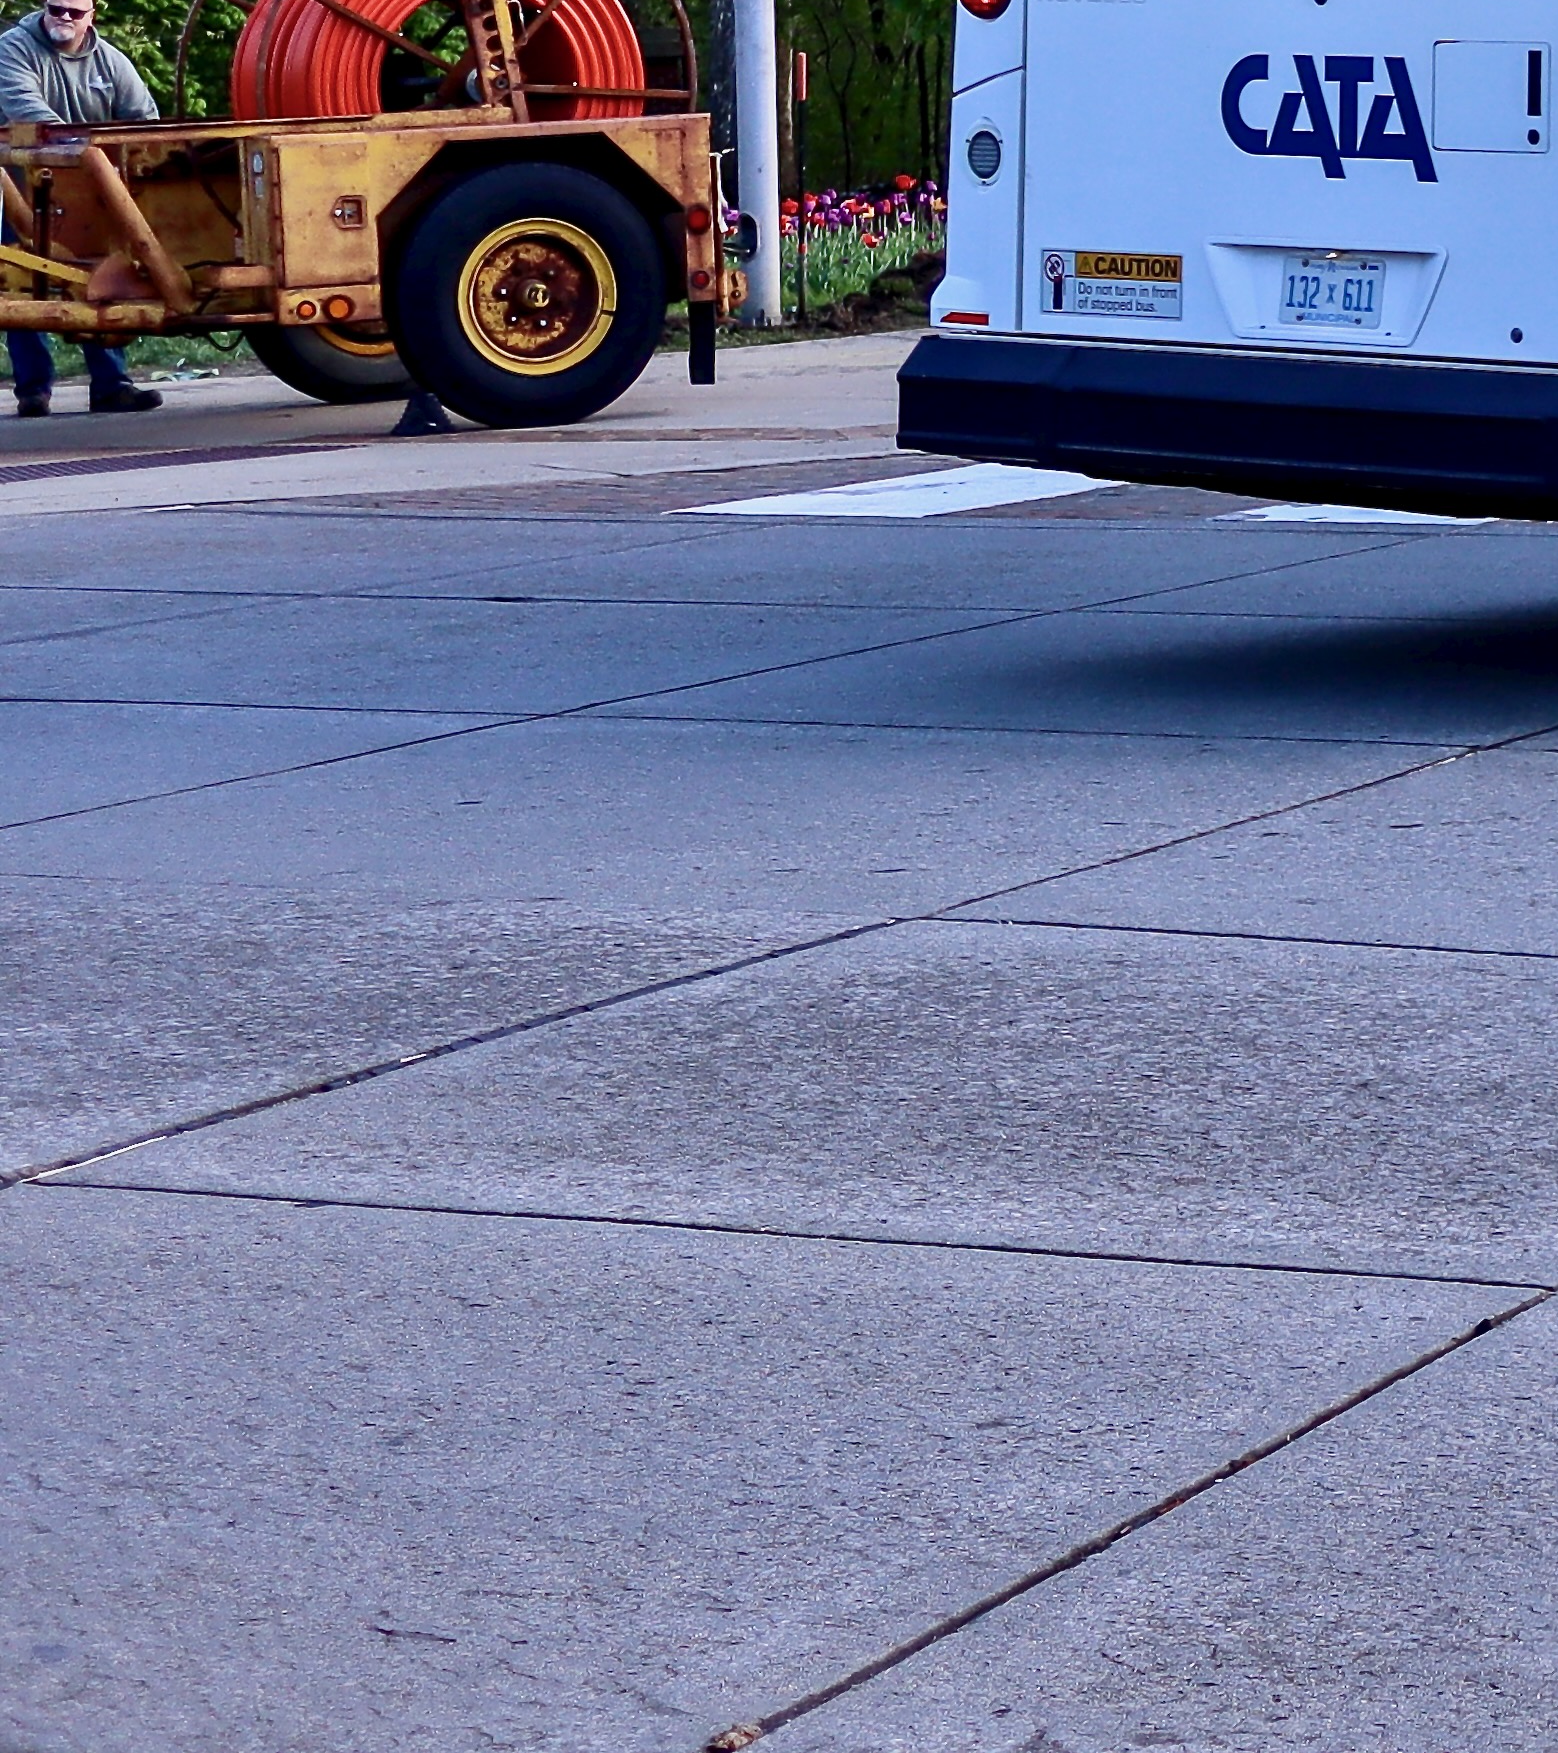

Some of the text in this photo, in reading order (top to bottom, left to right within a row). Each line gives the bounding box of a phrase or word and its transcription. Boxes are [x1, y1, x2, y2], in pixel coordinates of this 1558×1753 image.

[1220, 53, 1438, 183] CATA
[1094, 256, 1177, 278] CAUTION
[1078, 282, 1177, 299] Do not turn in front
[1286, 275, 1320, 309] 132
[1342, 279, 1374, 312] 611
[1078, 299, 1157, 312] of stopped bus.
